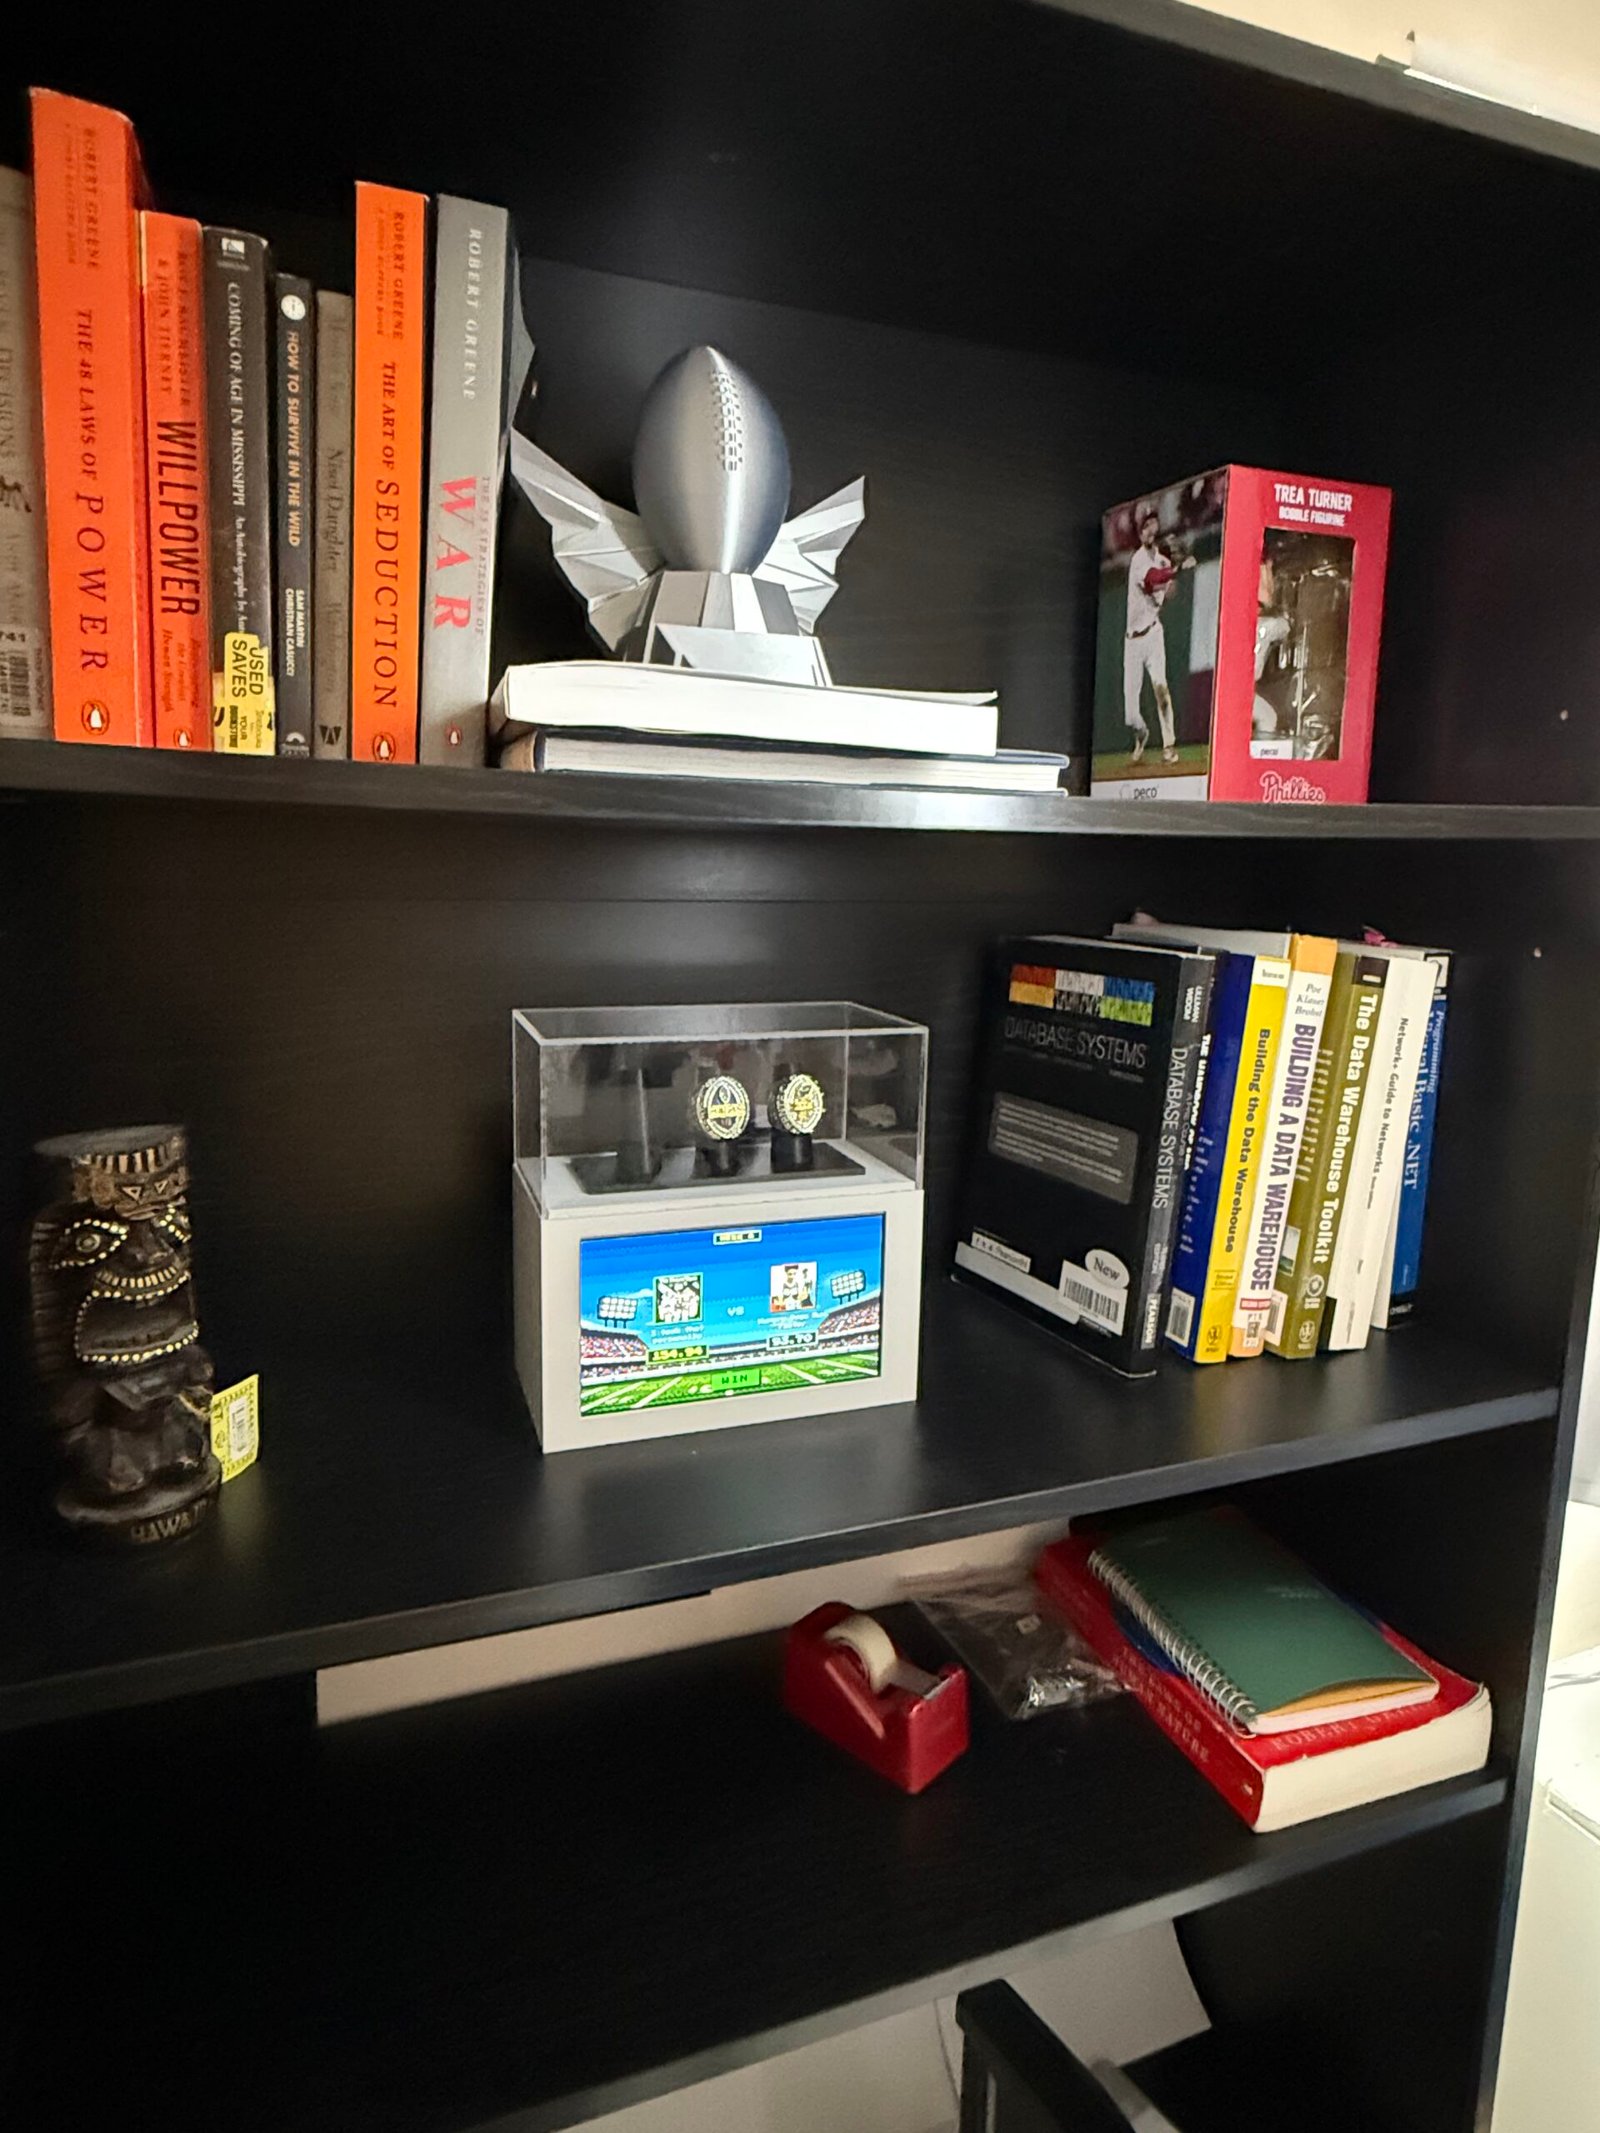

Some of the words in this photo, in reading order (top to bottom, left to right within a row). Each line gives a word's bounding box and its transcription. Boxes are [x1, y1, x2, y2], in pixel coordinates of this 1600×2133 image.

[393, 211, 405, 273] ROBERT
[465, 228, 482, 309] ROBERT
[77, 308, 94, 349] THE
[228, 282, 245, 347] COMING
[392, 278, 405, 340] GREENE
[79, 356, 93, 380] 48
[229, 350, 243, 373] OF
[287, 331, 302, 370] HOW
[463, 319, 480, 400] GREENE
[229, 375, 246, 405] AGE
[287, 373, 302, 393] TO
[382, 362, 397, 404] THE
[79, 384, 96, 444] LAWS
[229, 407, 246, 424] IN
[287, 395, 302, 456] SURVIVE
[382, 404, 397, 442] ART
[80, 454, 97, 481] OF
[230, 427, 246, 506] MISSISSIPPI
[288, 459, 302, 478] IN
[381, 445, 395, 470] OF
[157, 422, 200, 616] WILLPOWER
[287, 481, 302, 513] THE
[1274, 483, 1305, 505] TREA
[1308, 487, 1353, 512] TURNER
[287, 515, 301, 548] WILD
[323, 492, 344, 574] Daughter
[433, 476, 477, 630] WAR
[76, 493, 109, 671] POWER
[475, 527, 488, 613] STRATEGIES
[285, 588, 295, 636] CHRISTIAN
[295, 589, 305, 612] SAM
[373, 479, 400, 708] SEDUCTION
[295, 612, 304, 648] MARTIN
[231, 639, 248, 698] SAVES
[249, 647, 264, 695] USED
[239, 715, 249, 740] YOUR
[1133, 786, 1158, 799] peco
[1259, 770, 1326, 804] Phillies
[1191, 986, 1203, 1023] ULLMAN
[1305, 983, 1322, 993] Poe
[1355, 993, 1379, 1031] The
[1004, 1016, 1074, 1052] DATABASE
[1075, 1030, 1148, 1069] SYSTEMS
[1200, 1033, 1212, 1057] THE
[1248, 1028, 1271, 1094] Building
[1282, 1023, 1317, 1108] BUILDING
[1346, 1034, 1371, 1081] Data
[1393, 1017, 1409, 1070] Network+
[1426, 1010, 1446, 1094] Programming
[1162, 1047, 1189, 1131] DATABASE
[1245, 1096, 1261, 1122] the
[1385, 1072, 1400, 1105] Guide
[1410, 1078, 1427, 1134] Basic
[1278, 1112, 1300, 1126] A
[1382, 1107, 1393, 1120] to
[1239, 1127, 1255, 1163] Data
[1269, 1131, 1297, 1177] DATA
[1326, 1086, 1361, 1193] Warehouse
[1373, 1122, 1391, 1174] Networks
[1152, 1134, 1177, 1209] SYSTEMS
[1404, 1139, 1421, 1190] .NET
[1225, 1168, 1249, 1253] Warehouse
[1312, 1197, 1340, 1264] Toolkit
[1250, 1183, 1288, 1291] WAREHOUSE
[1094, 1256, 1121, 1281] New
[721, 1374, 748, 1385] WIN
